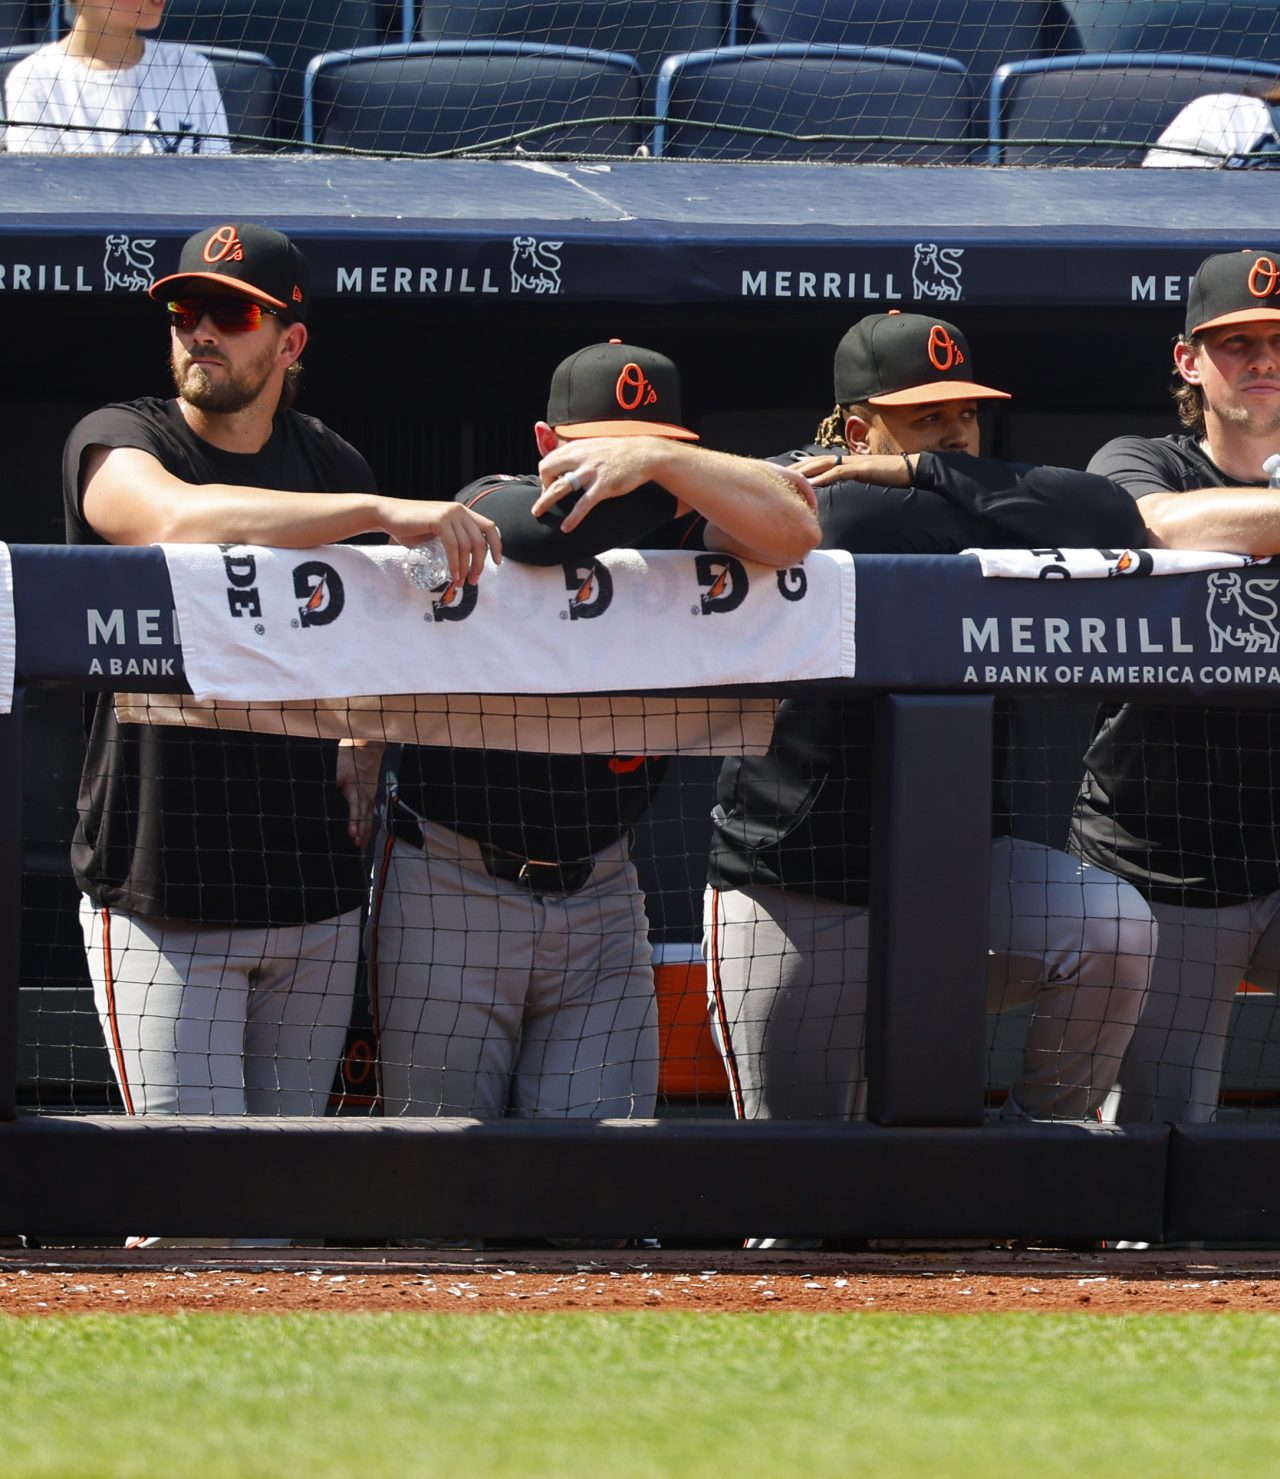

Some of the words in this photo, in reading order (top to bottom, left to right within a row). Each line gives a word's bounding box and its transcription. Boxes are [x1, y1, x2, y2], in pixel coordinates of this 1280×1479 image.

[201, 225, 245, 264] O's
[336, 267, 499, 293] MERRILL
[741, 270, 902, 299] MERRILL
[927, 324, 964, 371] O's
[615, 362, 658, 411] O's
[962, 617, 1194, 653] MERRILL
[88, 658, 104, 676] A
[109, 658, 175, 676] BANK
[963, 665, 979, 683] A
[985, 665, 1049, 683] BANK
[1054, 665, 1084, 684] OF
[1089, 665, 1195, 684] AMERICA
